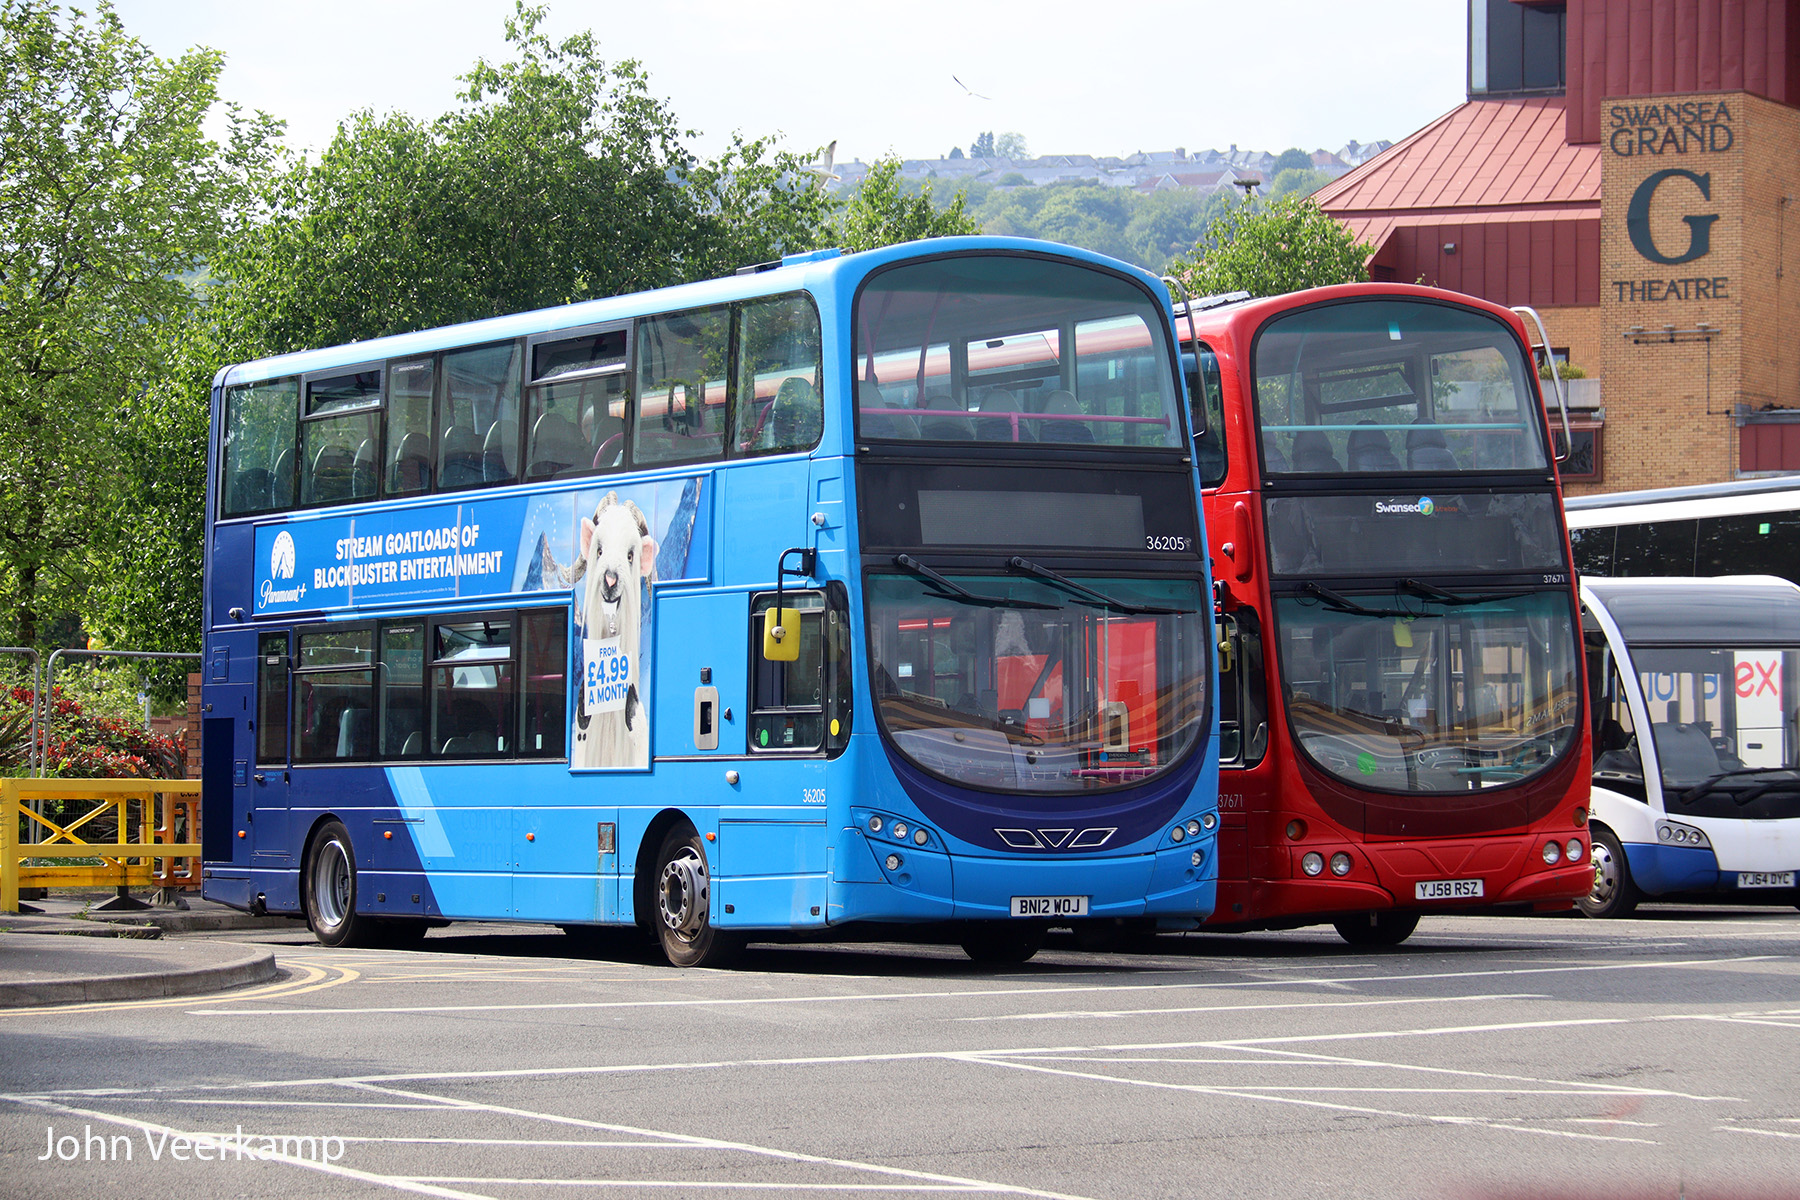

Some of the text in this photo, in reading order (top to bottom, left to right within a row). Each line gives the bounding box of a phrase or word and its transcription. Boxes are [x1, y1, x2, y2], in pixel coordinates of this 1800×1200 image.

[1609, 101, 1732, 128] SWANSEA
[1609, 123, 1733, 157] GRAND
[1626, 168, 1720, 265] G
[1612, 276, 1730, 302] THEATRE
[1375, 501, 1421, 513] Swansea
[336, 524, 480, 561] STREAM GOATLOADS OF
[1146, 535, 1185, 551] 36205
[313, 550, 503, 589] BLOCKBUSTER ENTERTAINMENT
[1543, 574, 1565, 584] 37671
[599, 646, 617, 658] FROM
[587, 655, 629, 687] £4.99
[588, 682, 629, 706] A MONTH
[802, 788, 826, 803] 36205
[1218, 793, 1243, 808] 37671
[1742, 873, 1790, 885] YJ64 DYC
[1420, 881, 1478, 897] YJ58 RSZ
[1020, 898, 1080, 914] BN12 WOJ
